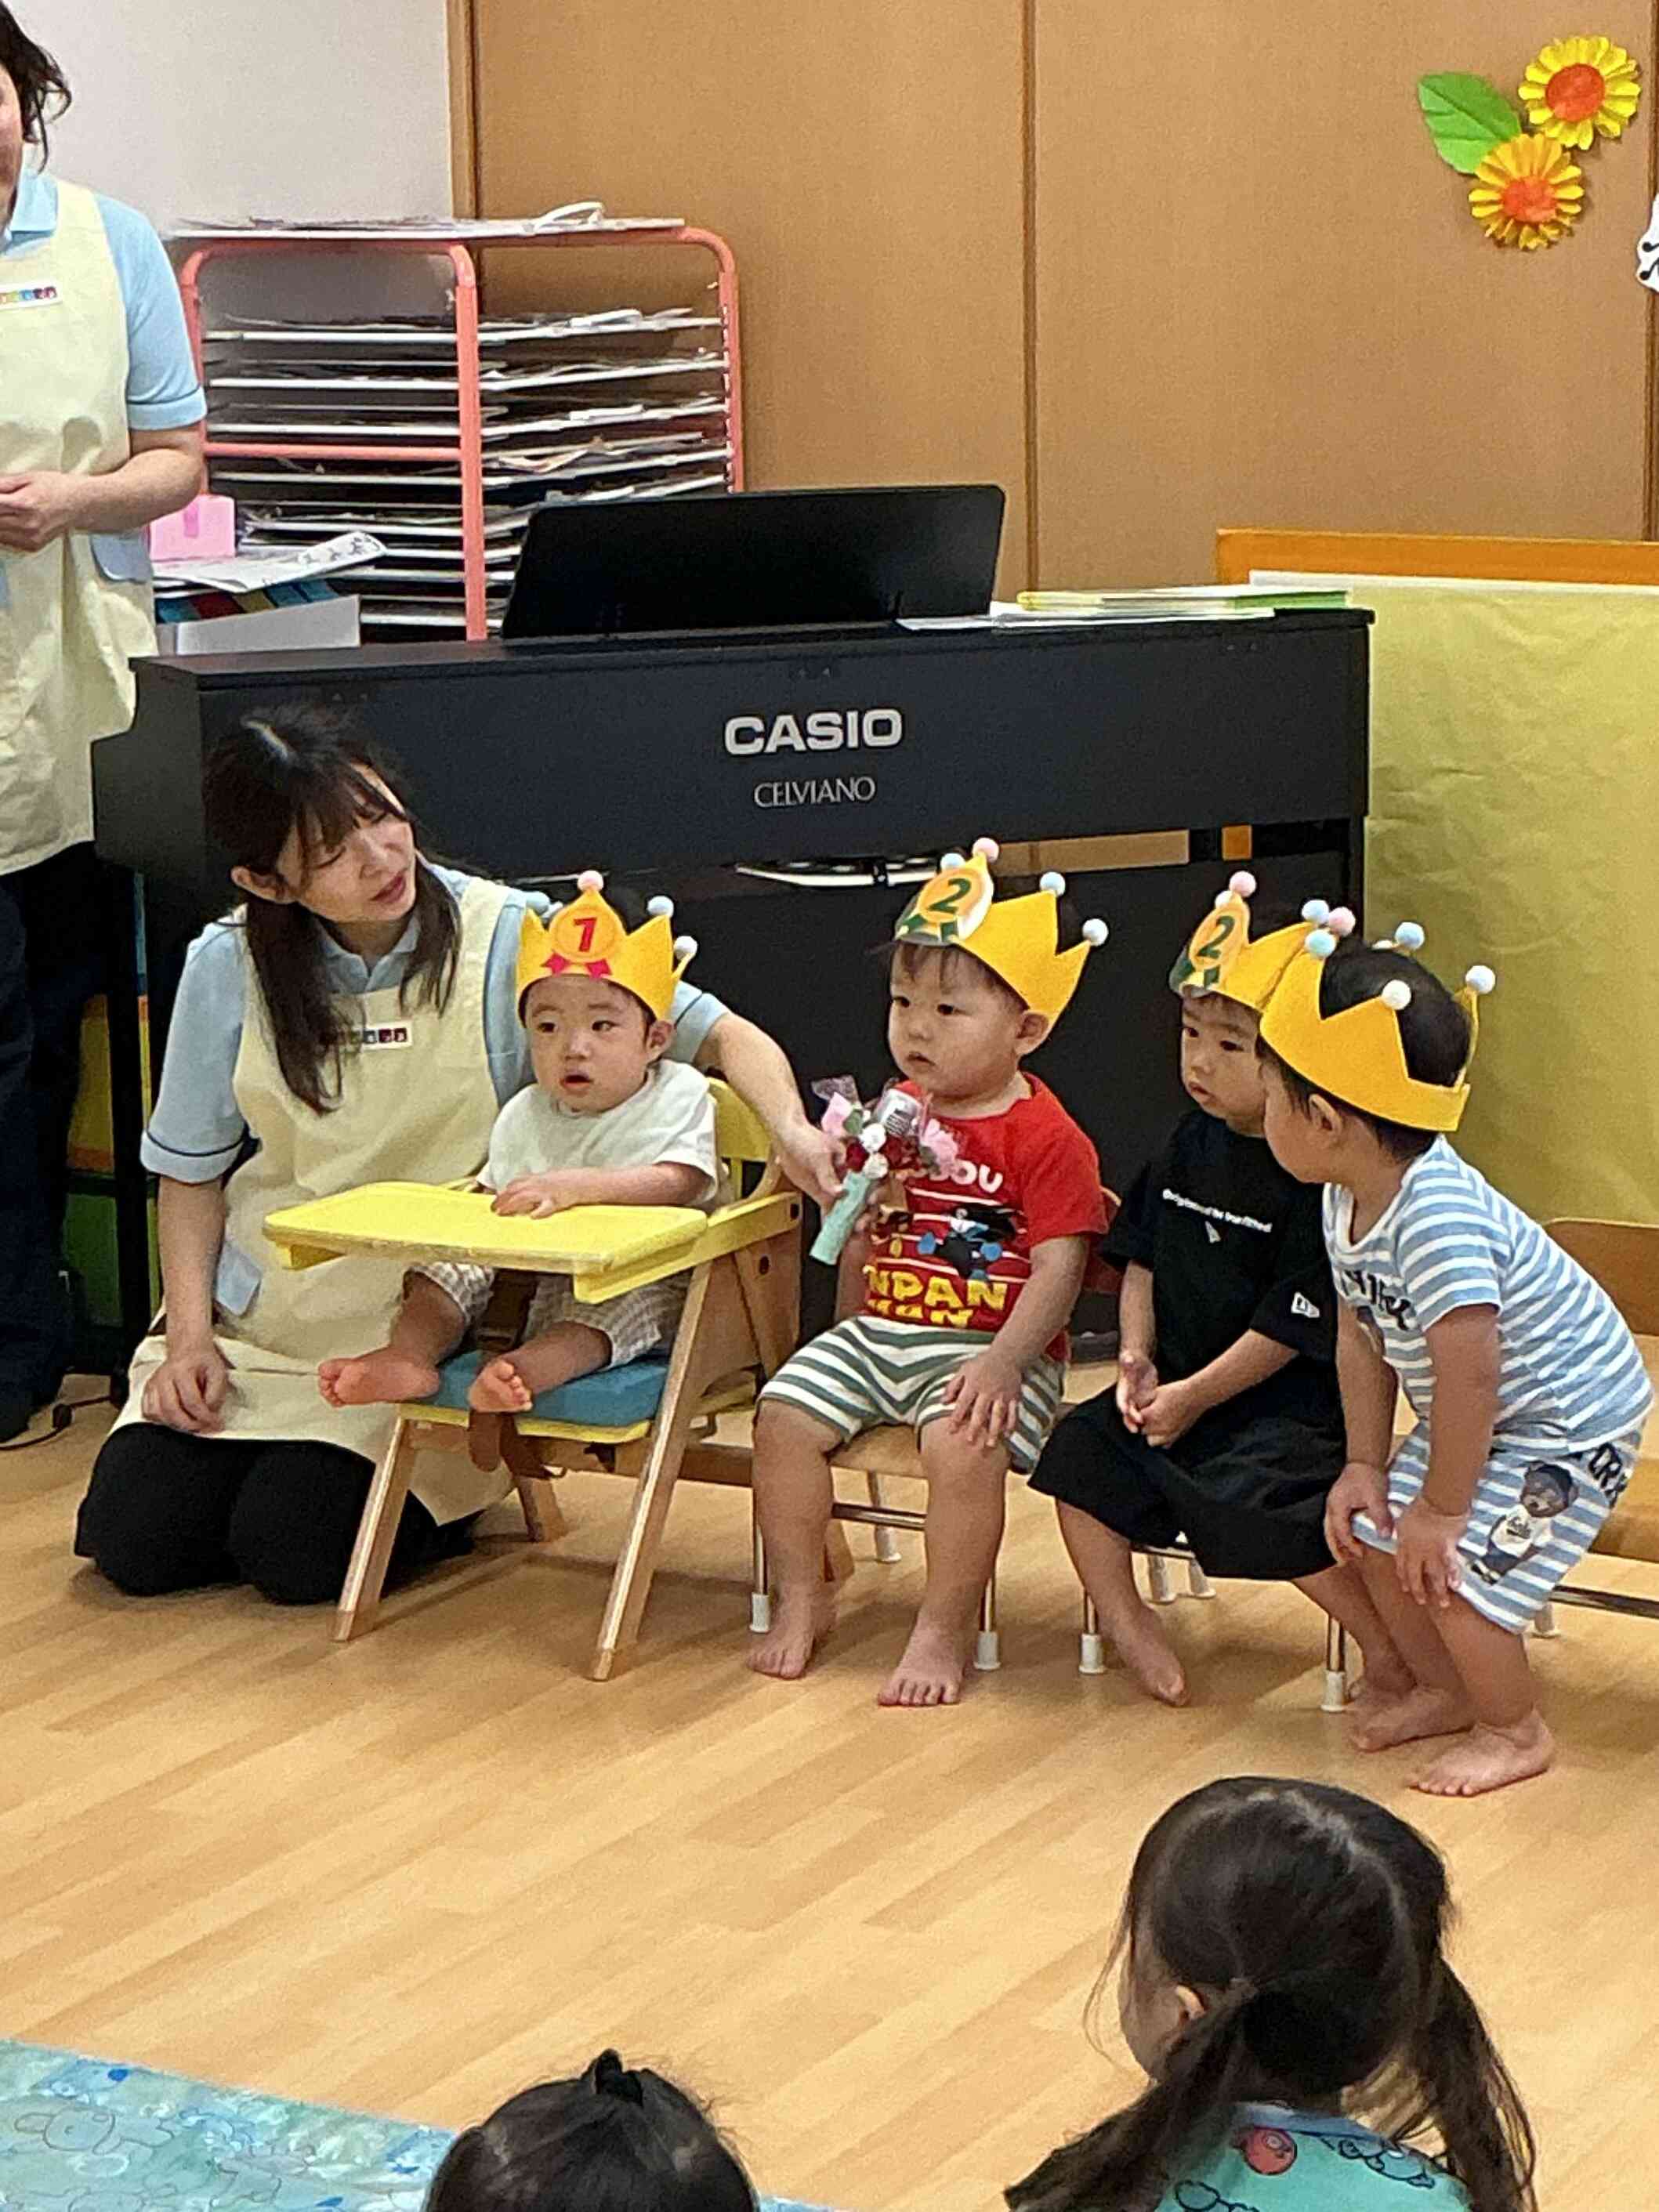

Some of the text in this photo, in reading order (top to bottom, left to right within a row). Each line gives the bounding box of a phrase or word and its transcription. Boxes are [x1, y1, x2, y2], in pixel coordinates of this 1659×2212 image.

[724, 708, 902, 755] CASIO
[753, 777, 876, 808] CELVIANO
[931, 878, 971, 914] 2
[573, 916, 597, 953] 1
[1199, 915, 1234, 958] 2
